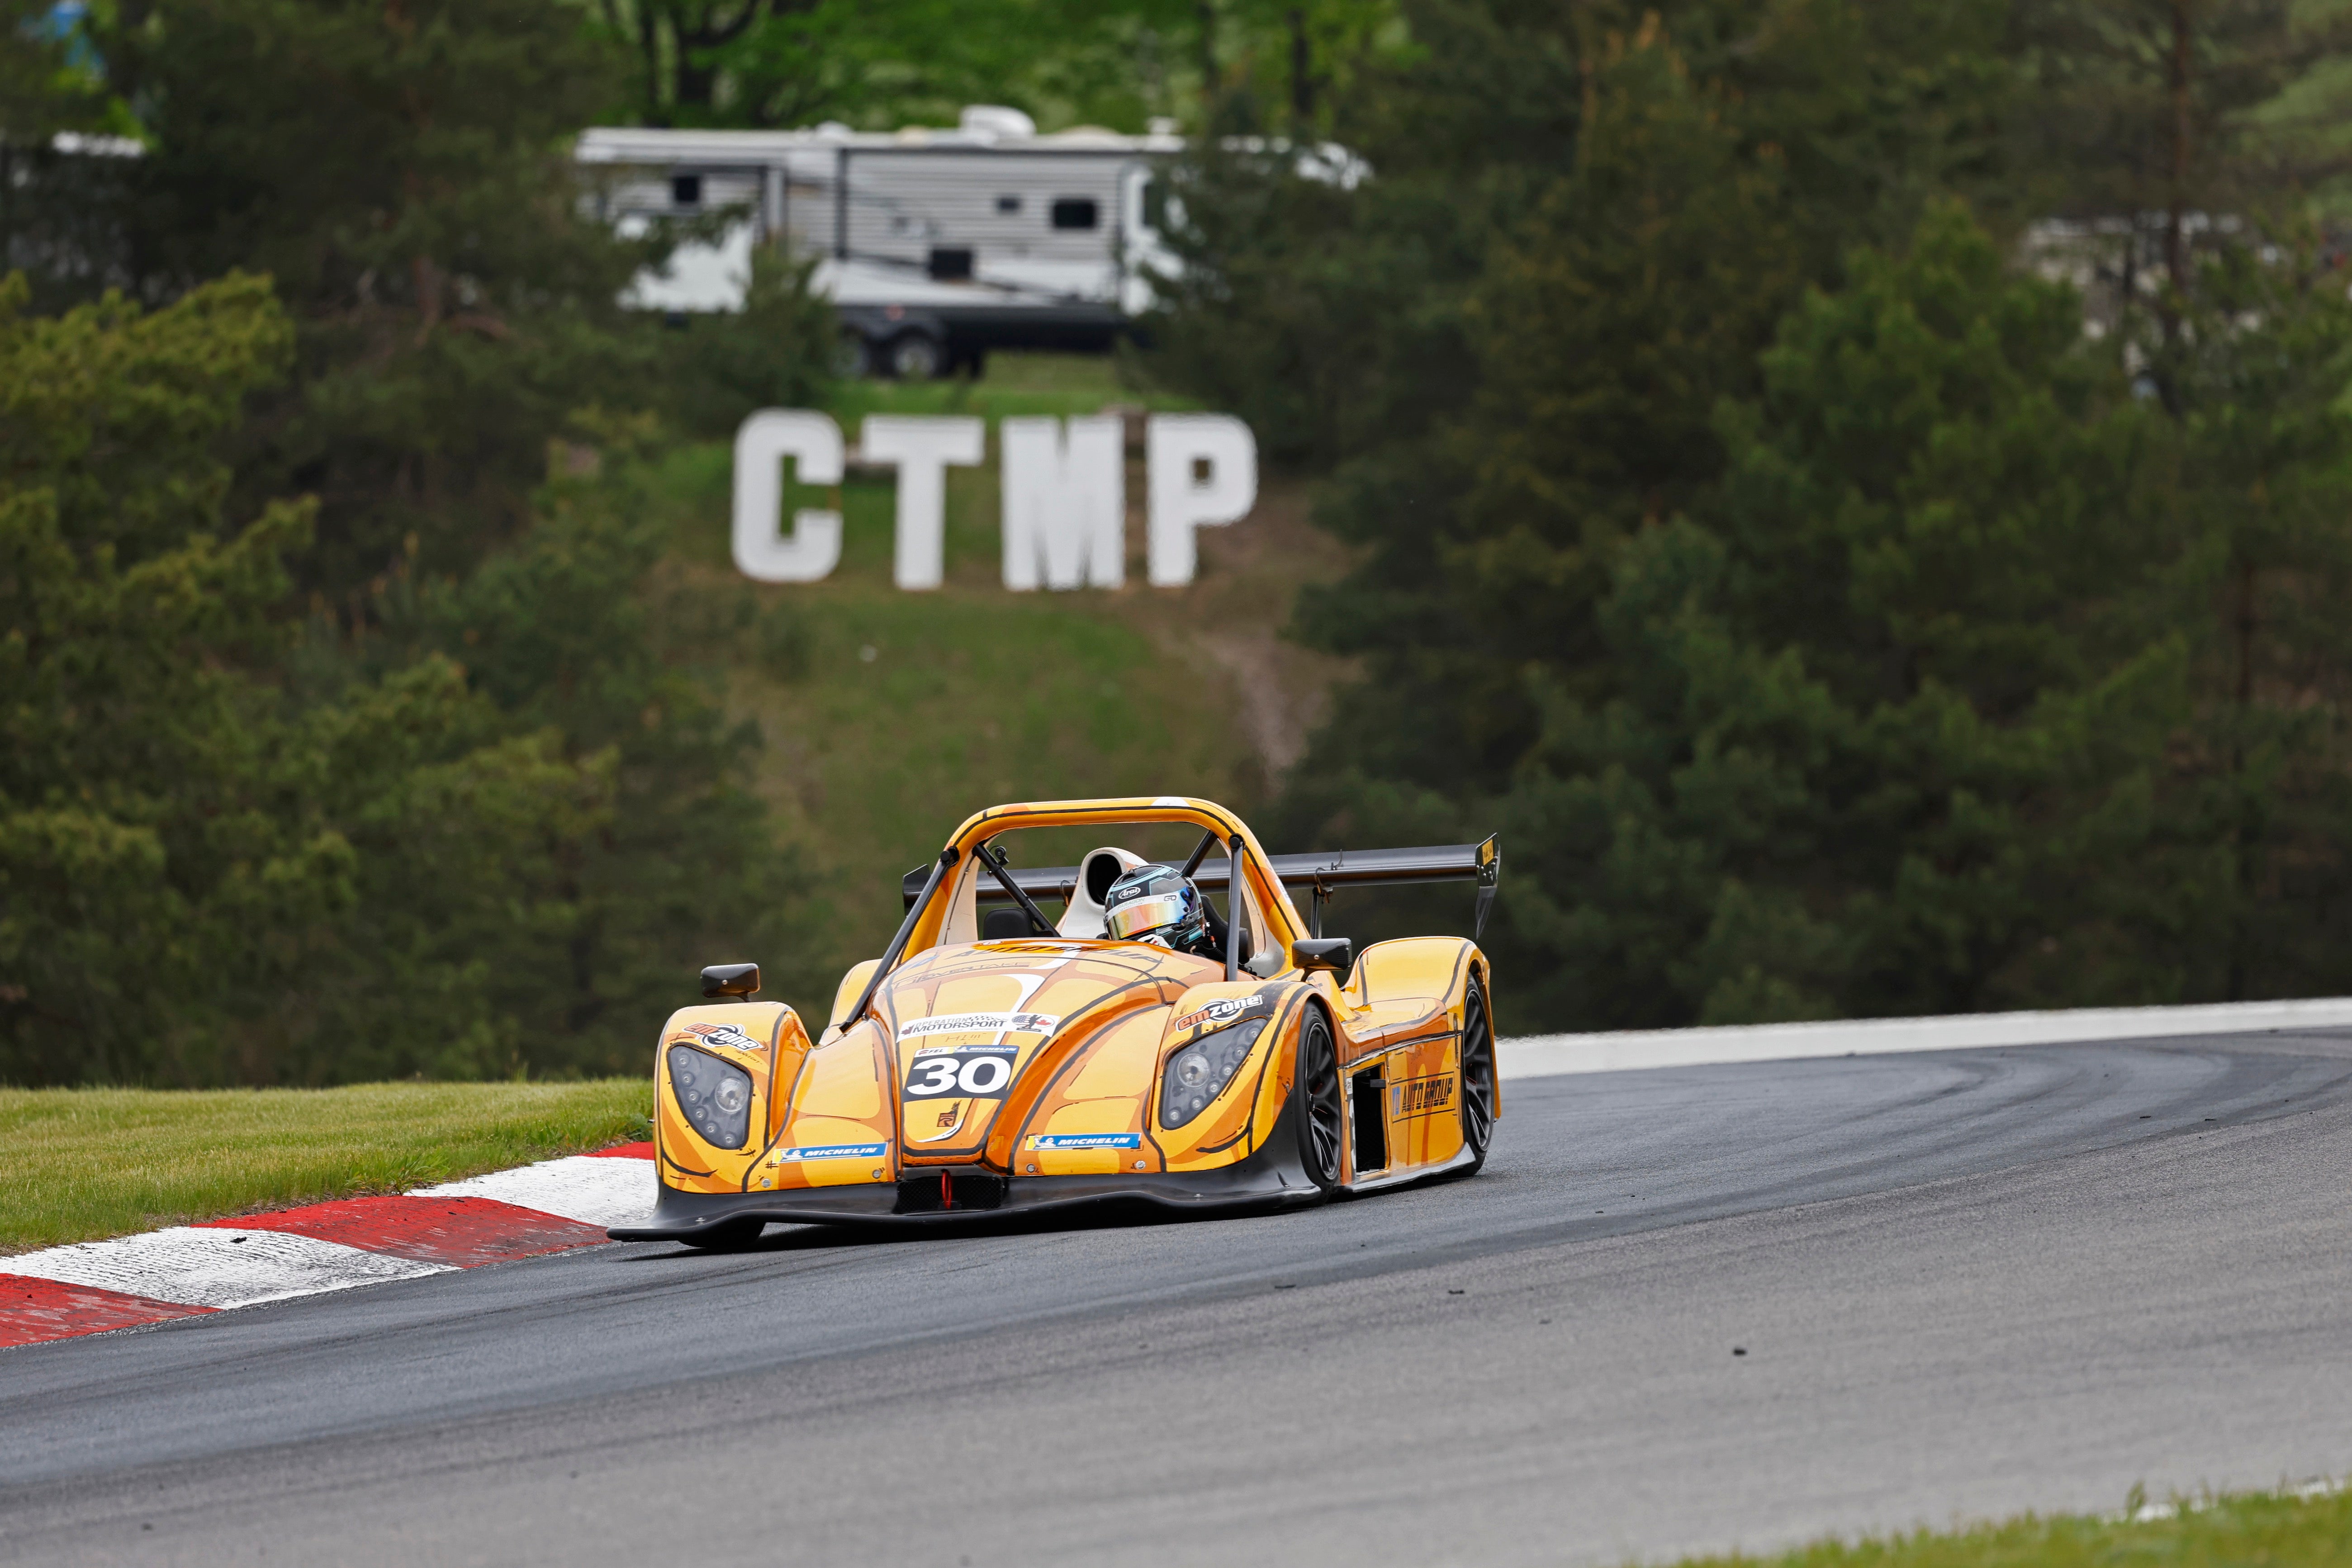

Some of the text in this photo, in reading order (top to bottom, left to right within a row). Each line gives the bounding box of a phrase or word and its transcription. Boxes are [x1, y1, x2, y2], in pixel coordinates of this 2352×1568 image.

[732, 408, 1259, 591] CTMP
[1119, 888, 1138, 898] Arai
[920, 962, 1032, 981] OVERTAKE
[1177, 995, 1260, 1030] emzone
[913, 1020, 1008, 1033] MOTORSPORT
[915, 1017, 969, 1028] OPERATION
[684, 1023, 759, 1050] emzone
[906, 1056, 1011, 1095] 30
[1402, 1082, 1424, 1113] AUTO
[1423, 1077, 1453, 1109] GROUP
[1057, 1137, 1130, 1145] MICHELIN
[804, 1147, 878, 1156] MICHELIN
